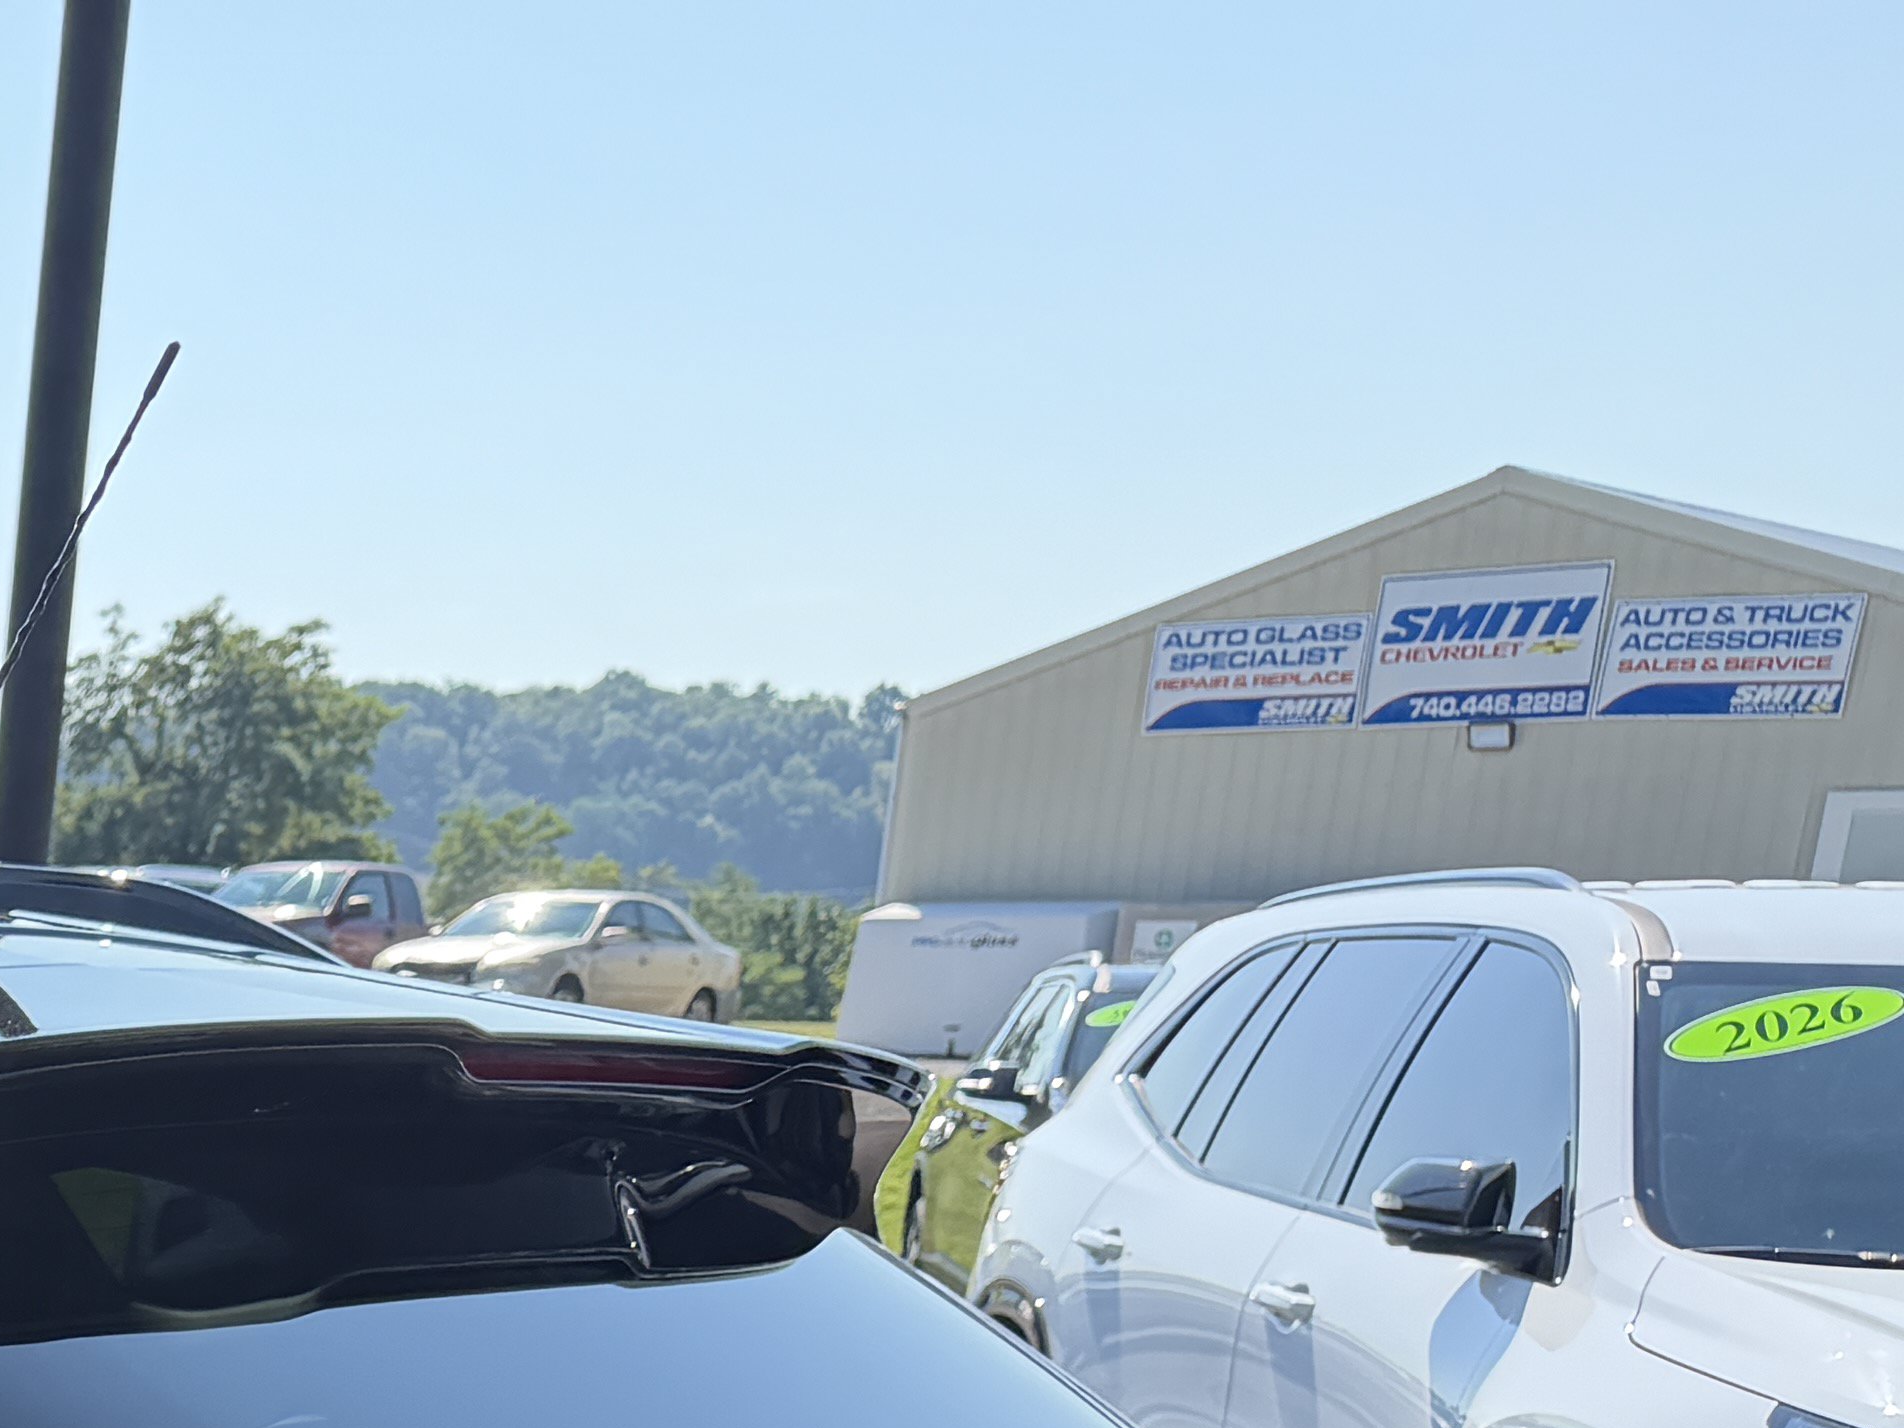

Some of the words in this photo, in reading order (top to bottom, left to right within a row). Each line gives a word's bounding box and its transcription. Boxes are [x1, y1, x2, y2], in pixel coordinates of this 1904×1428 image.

[1381, 595, 1599, 644] SMITH
[1619, 605, 1708, 628] AUTO
[1712, 604, 1736, 625] &
[1744, 601, 1857, 624] TRUCK
[1163, 628, 1249, 649] AUTO
[1255, 622, 1364, 645] GLASS
[1619, 628, 1843, 652] ACCESSORIES
[1169, 646, 1349, 671] SPECIALIST
[1380, 641, 1526, 665] CHEVROLET
[1617, 656, 1697, 674] SALES
[1700, 656, 1719, 672] &
[1723, 654, 1834, 672] SERVICE
[1154, 674, 1230, 691] REPAIR
[1233, 673, 1248, 689] &
[1252, 670, 1355, 687] REPLACE
[1409, 690, 1586, 719] 740.446.2282
[1729, 684, 1842, 705] SMITH
[1715, 991, 1863, 1056] 2026
